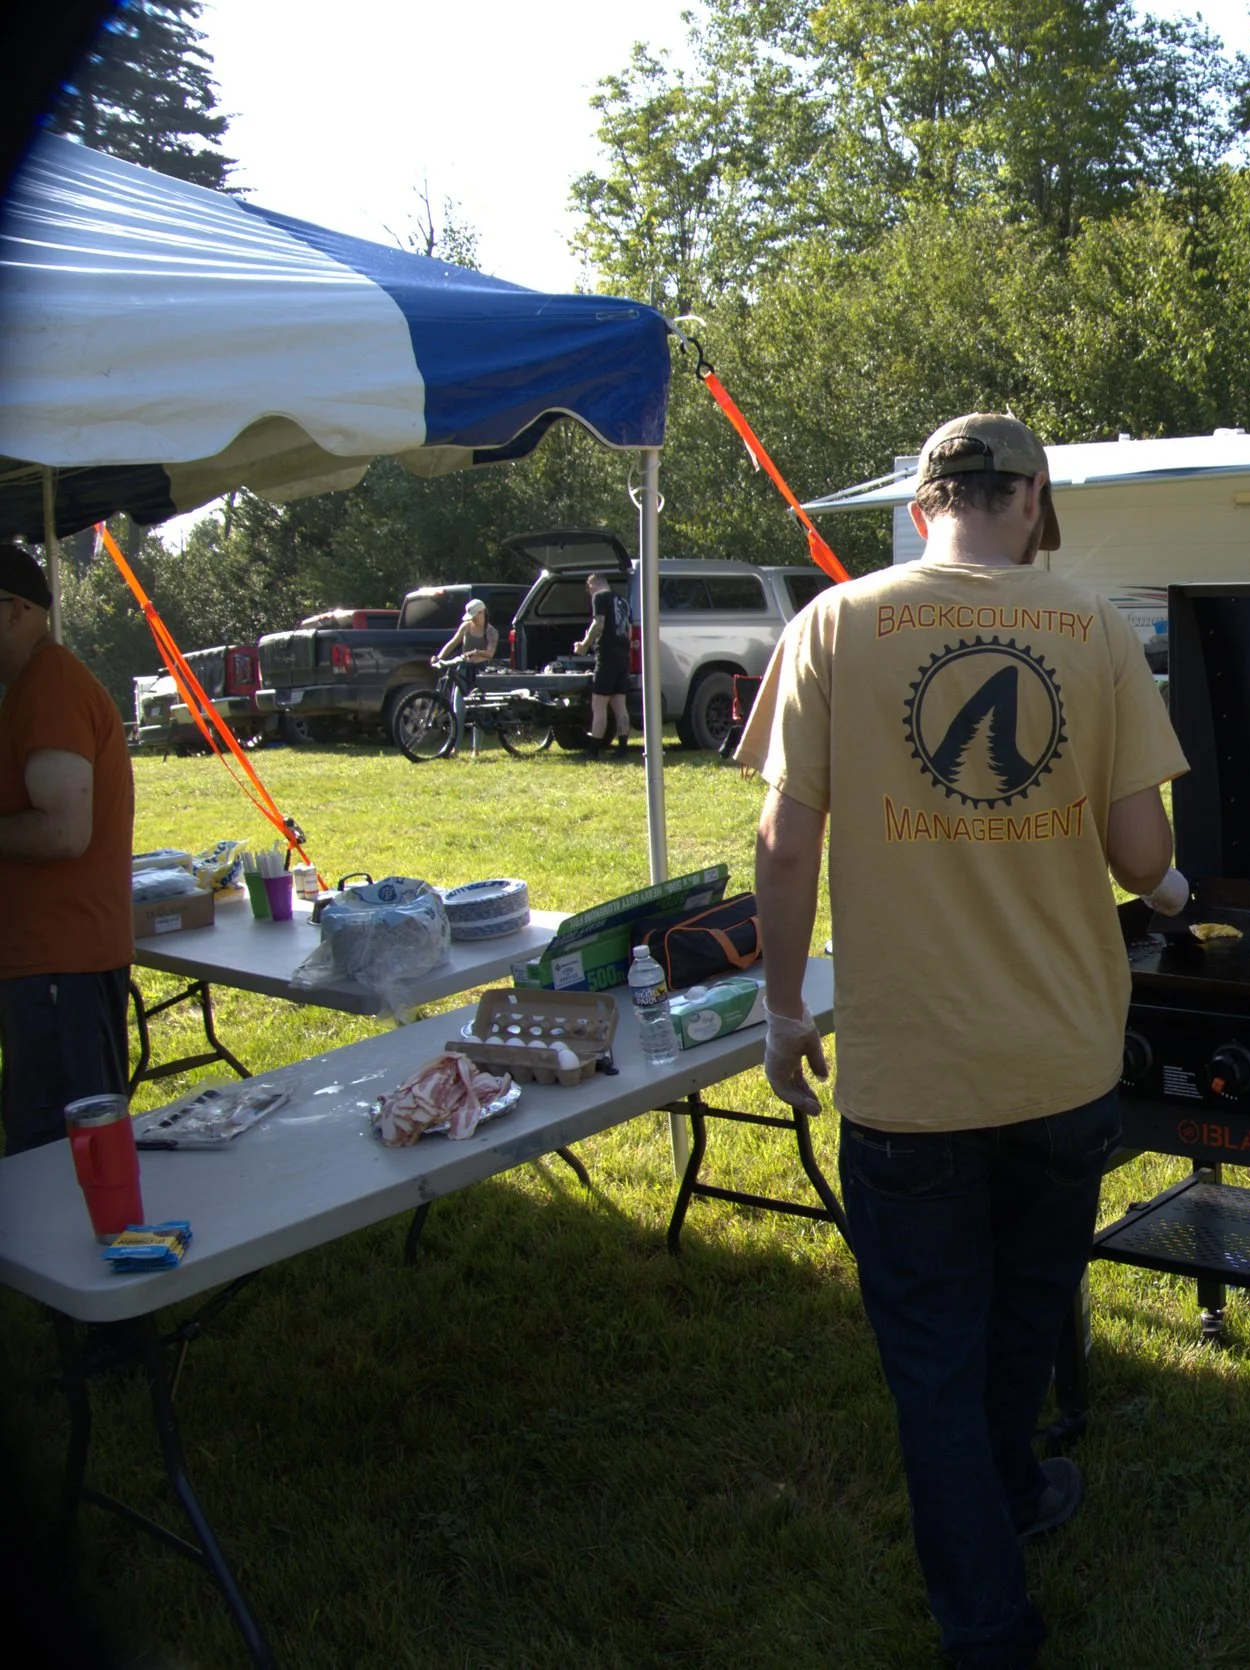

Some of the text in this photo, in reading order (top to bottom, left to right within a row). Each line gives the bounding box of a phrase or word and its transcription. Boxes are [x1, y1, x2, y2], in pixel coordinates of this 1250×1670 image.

[877, 603, 1094, 642] BACKCOUNTRY
[883, 794, 1088, 841] MANAGEMENT
[621, 894, 640, 908] DUTY
[641, 887, 662, 902] HEAVY
[584, 900, 621, 920] ALUMINUM
[570, 916, 584, 929] FOIL
